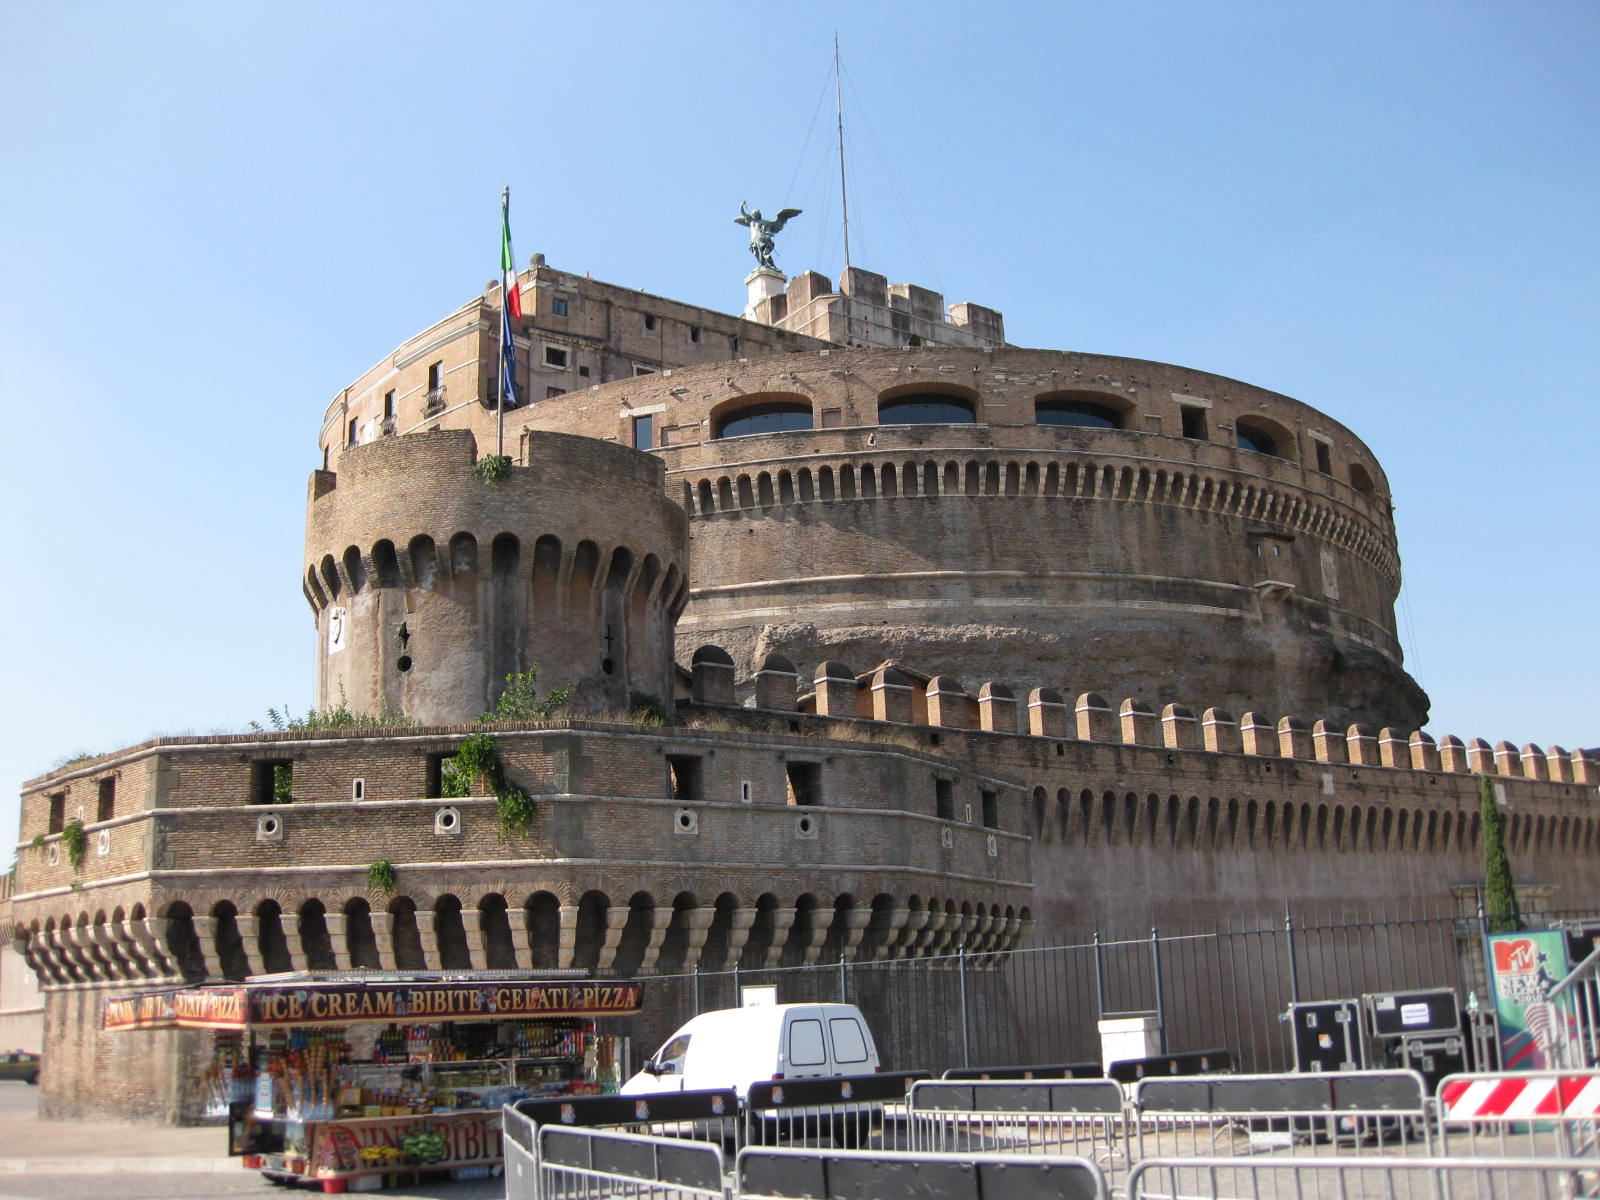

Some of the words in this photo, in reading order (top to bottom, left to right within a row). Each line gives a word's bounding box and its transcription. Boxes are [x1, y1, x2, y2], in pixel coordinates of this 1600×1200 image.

[1493, 939, 1538, 973] MTV
[1499, 975, 1539, 991] NEW
[211, 994, 241, 1019] PIZZA
[262, 994, 303, 1020] ICE
[311, 990, 395, 1018] CREAM
[411, 987, 481, 1014] BIBITE
[496, 987, 569, 1012] GELATI
[582, 986, 637, 1010] PIZZA
